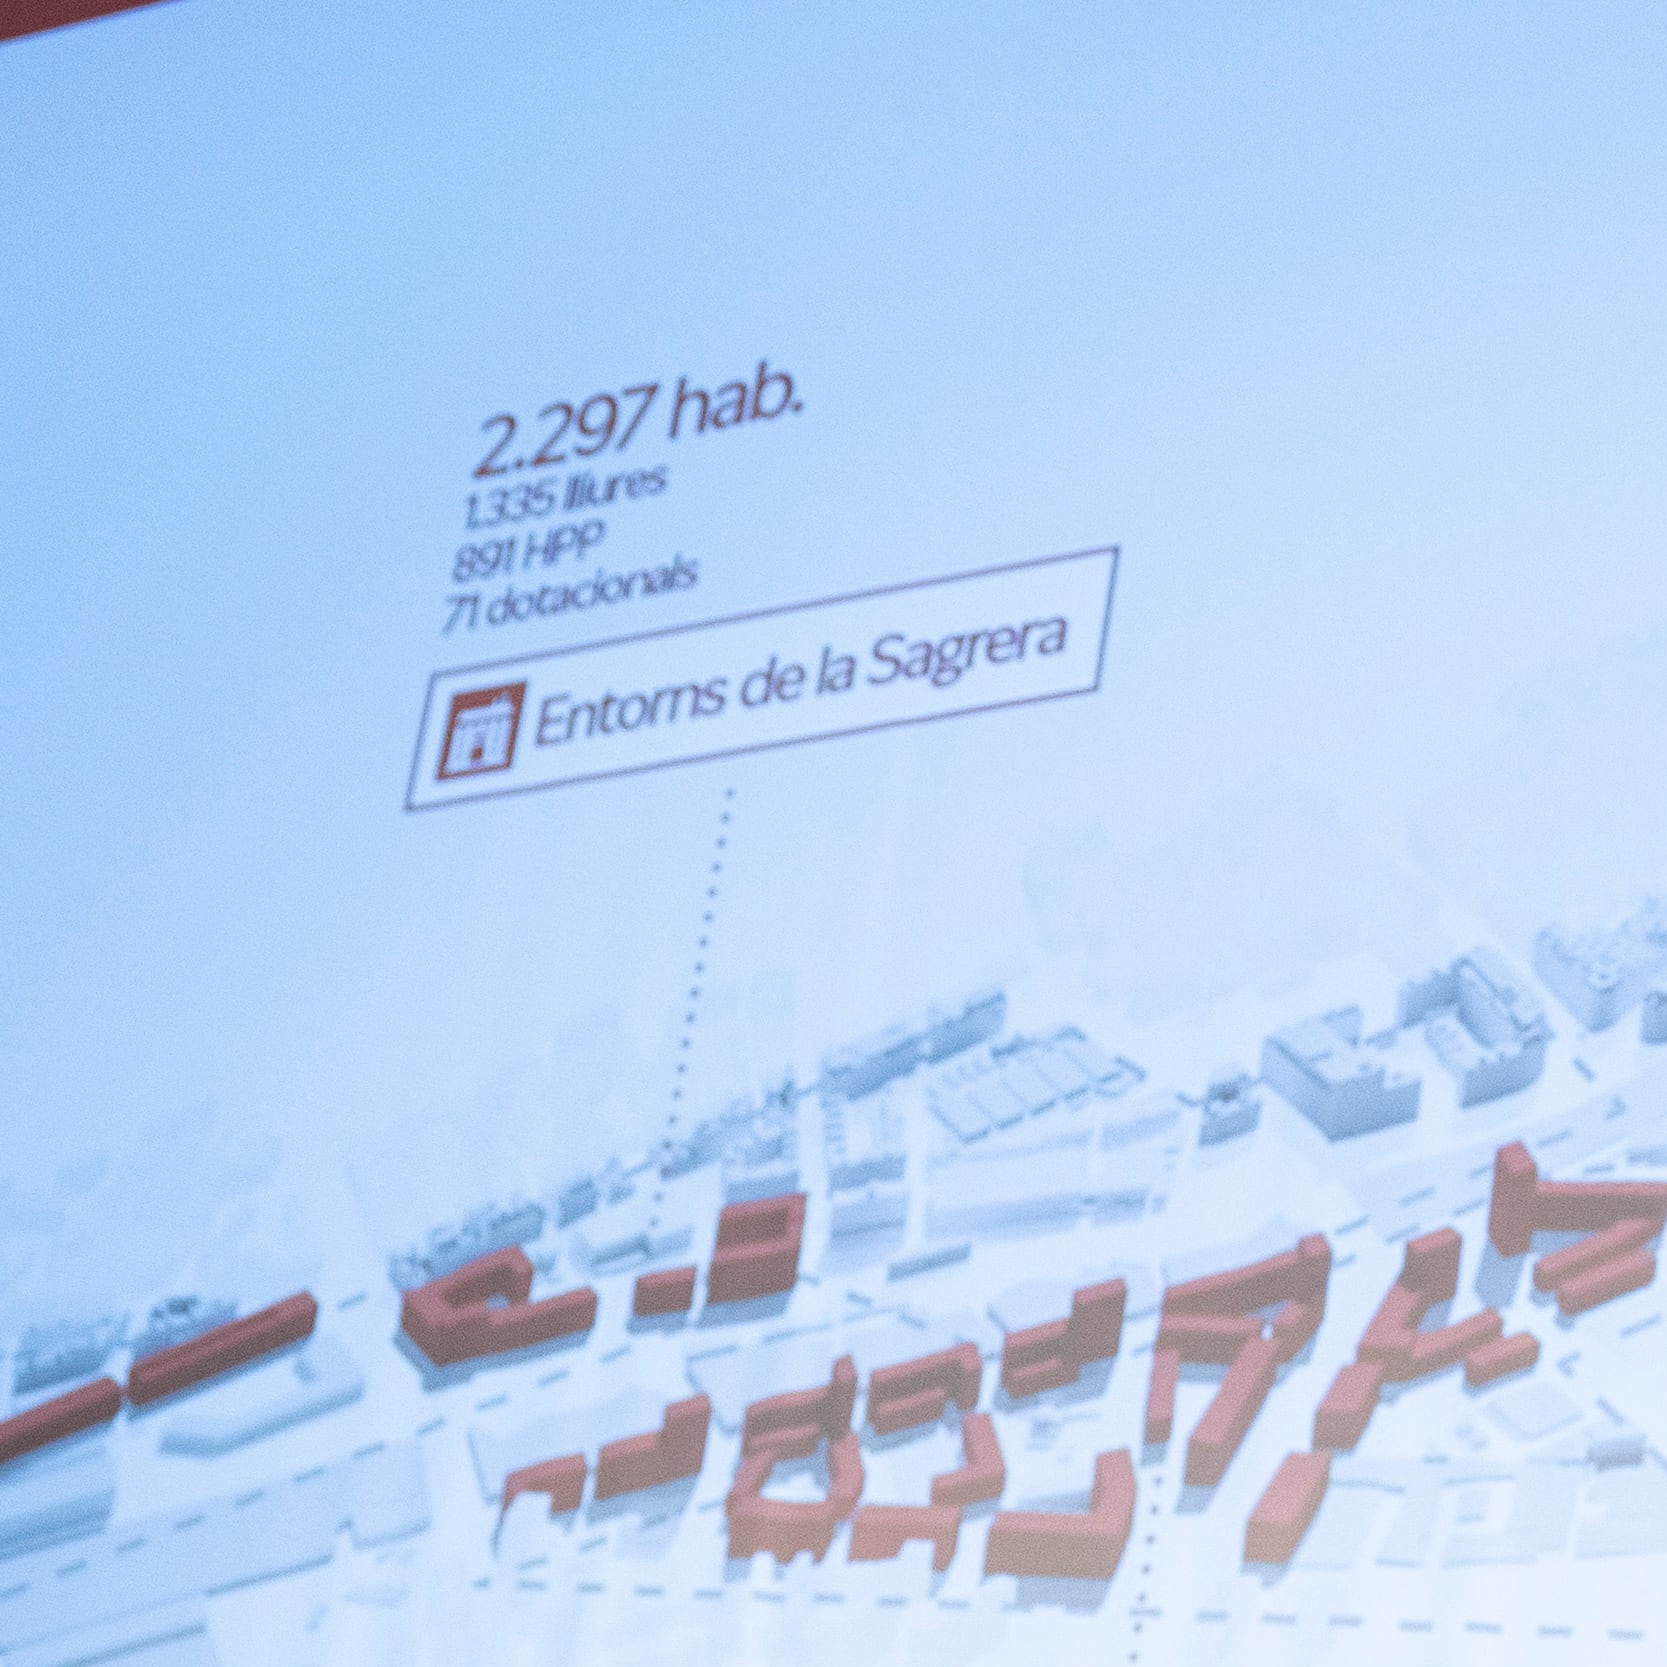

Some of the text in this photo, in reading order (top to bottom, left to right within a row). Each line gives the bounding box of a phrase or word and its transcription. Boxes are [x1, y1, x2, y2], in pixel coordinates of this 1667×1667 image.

[472, 359, 804, 481] 2.297 hab.
[564, 464, 669, 510] lliures
[442, 551, 700, 636] 71 dotacionals
[453, 518, 607, 584] 891 HPP
[534, 614, 1069, 748] Entorns de la Sagrera
